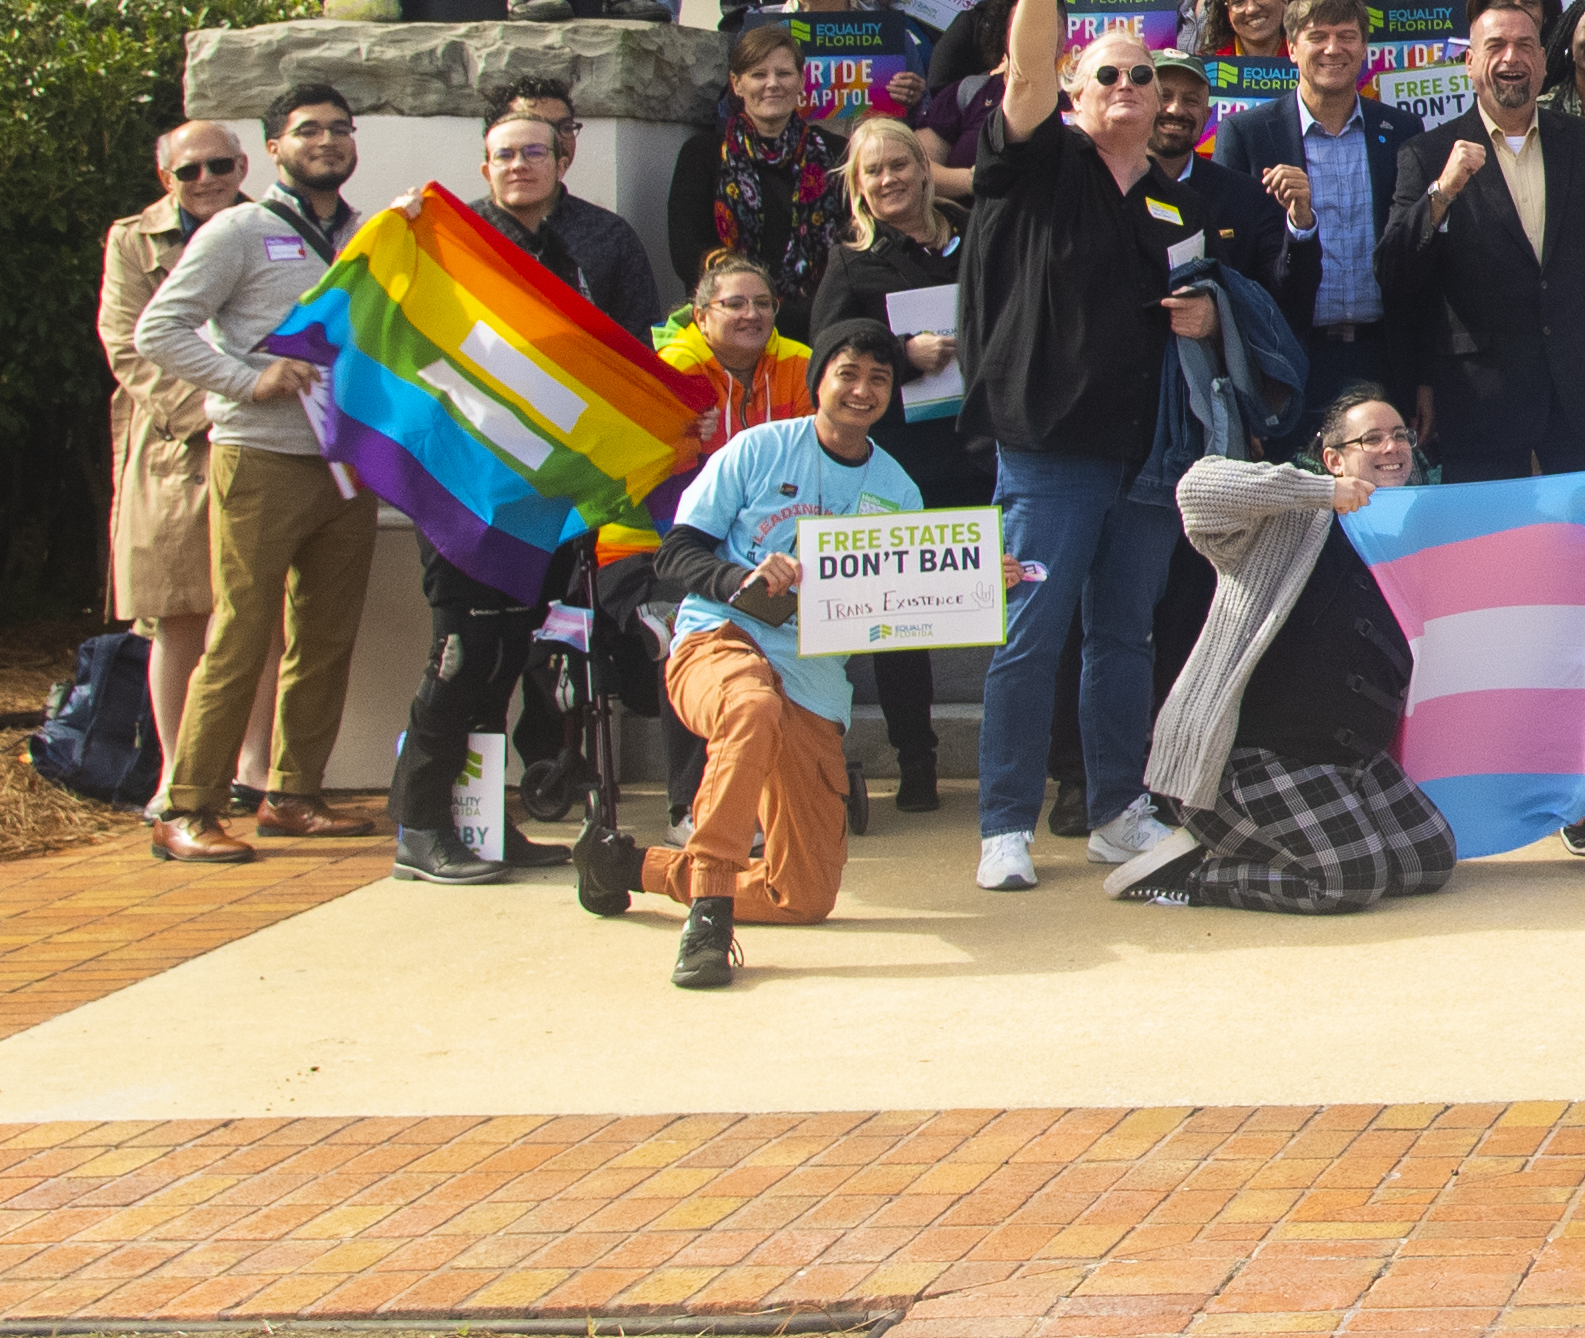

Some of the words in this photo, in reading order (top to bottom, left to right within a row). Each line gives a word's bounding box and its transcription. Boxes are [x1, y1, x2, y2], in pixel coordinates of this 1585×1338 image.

[797, 87, 873, 108] CAPITOL
[1393, 77, 1443, 98] FREE
[1396, 93, 1466, 119] DON'T
[817, 528, 881, 552] FREE
[889, 522, 981, 547] STATES
[819, 550, 909, 579] DON'T
[919, 546, 980, 573] BAN
[883, 585, 964, 611] EXISTENCE
